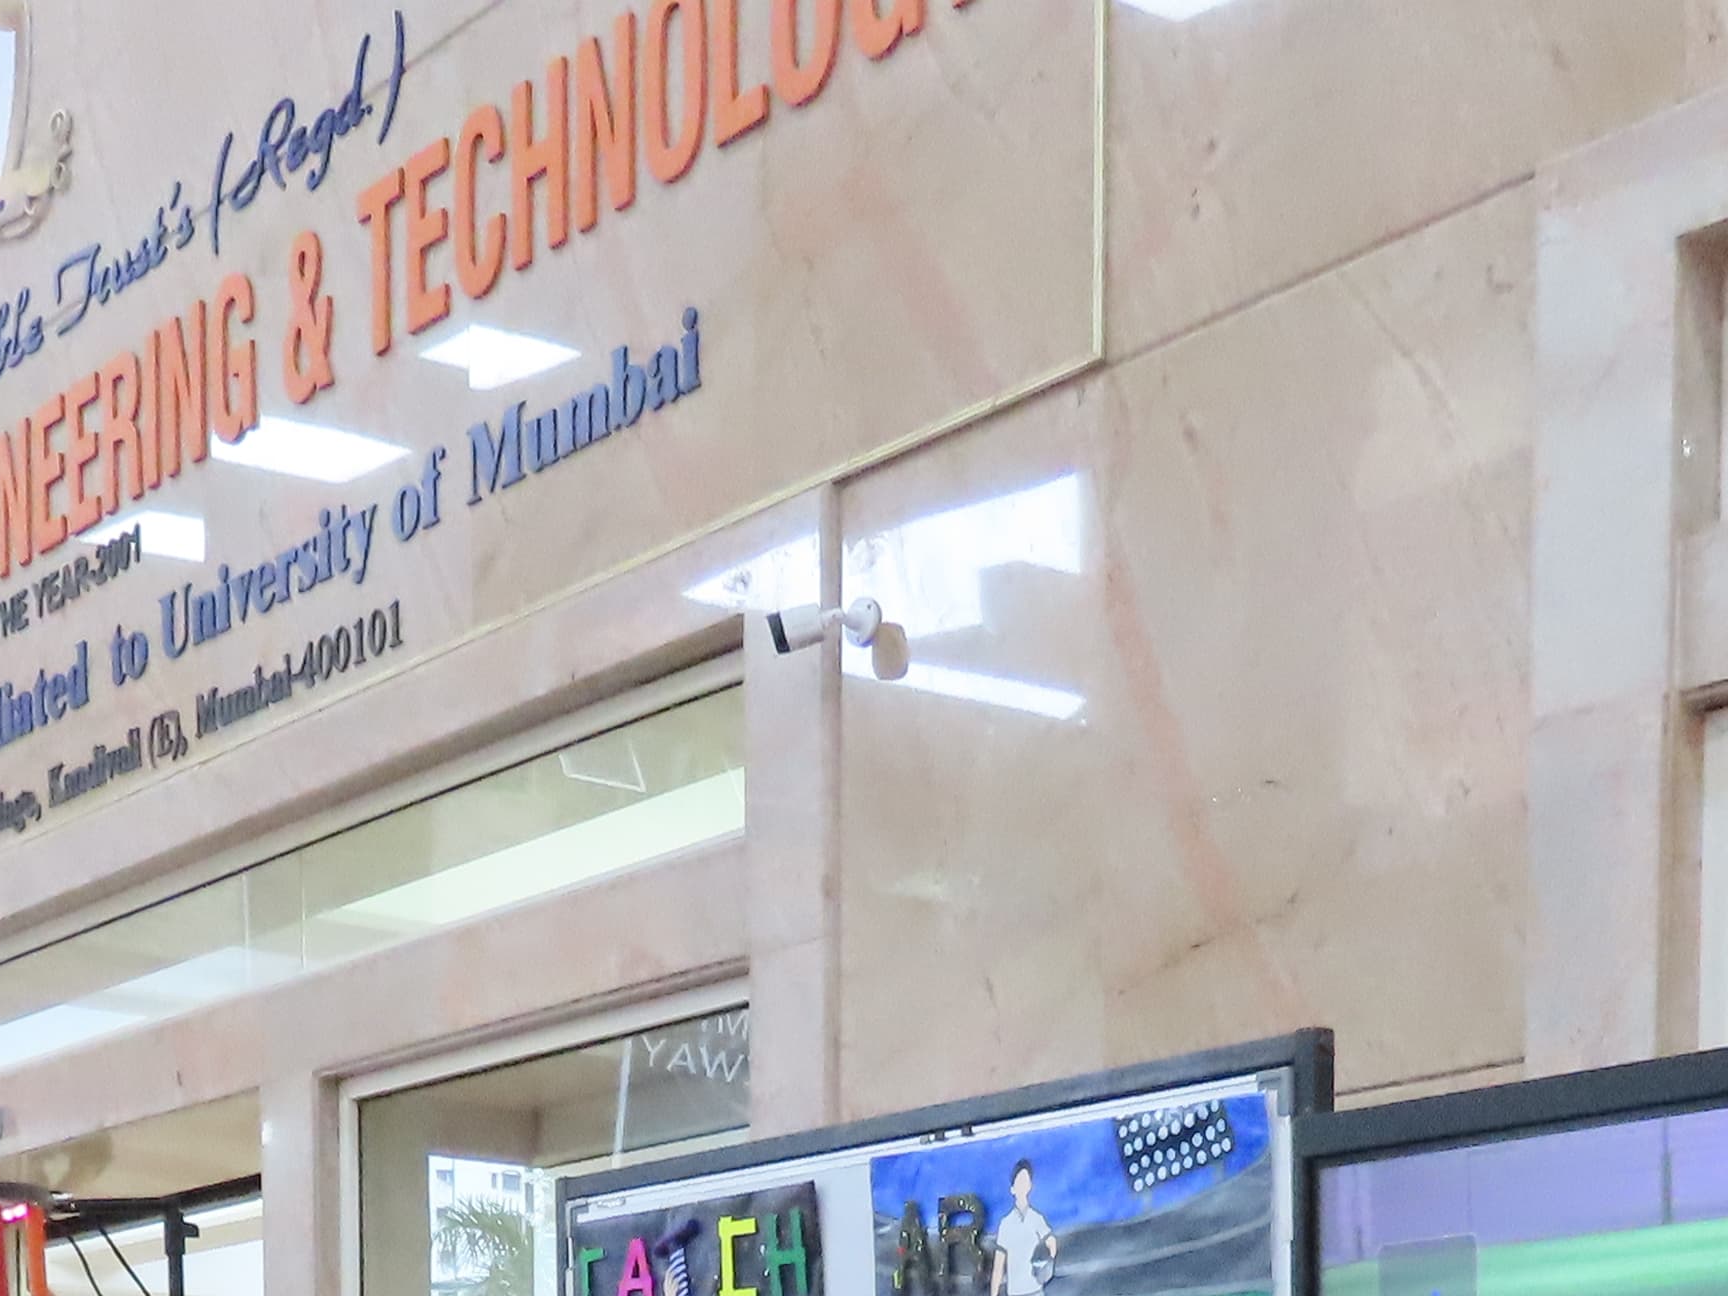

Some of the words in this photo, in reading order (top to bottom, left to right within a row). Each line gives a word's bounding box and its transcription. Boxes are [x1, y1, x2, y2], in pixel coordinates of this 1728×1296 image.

[56, 181, 195, 338] Trust's
[209, 9, 406, 257] (Regd.)
[283, 231, 335, 405] &
[356, 0, 973, 357] TECHNOLO
[110, 624, 150, 687] to
[159, 500, 378, 659] University
[391, 445, 446, 544] of
[466, 307, 703, 506] Mumbai
